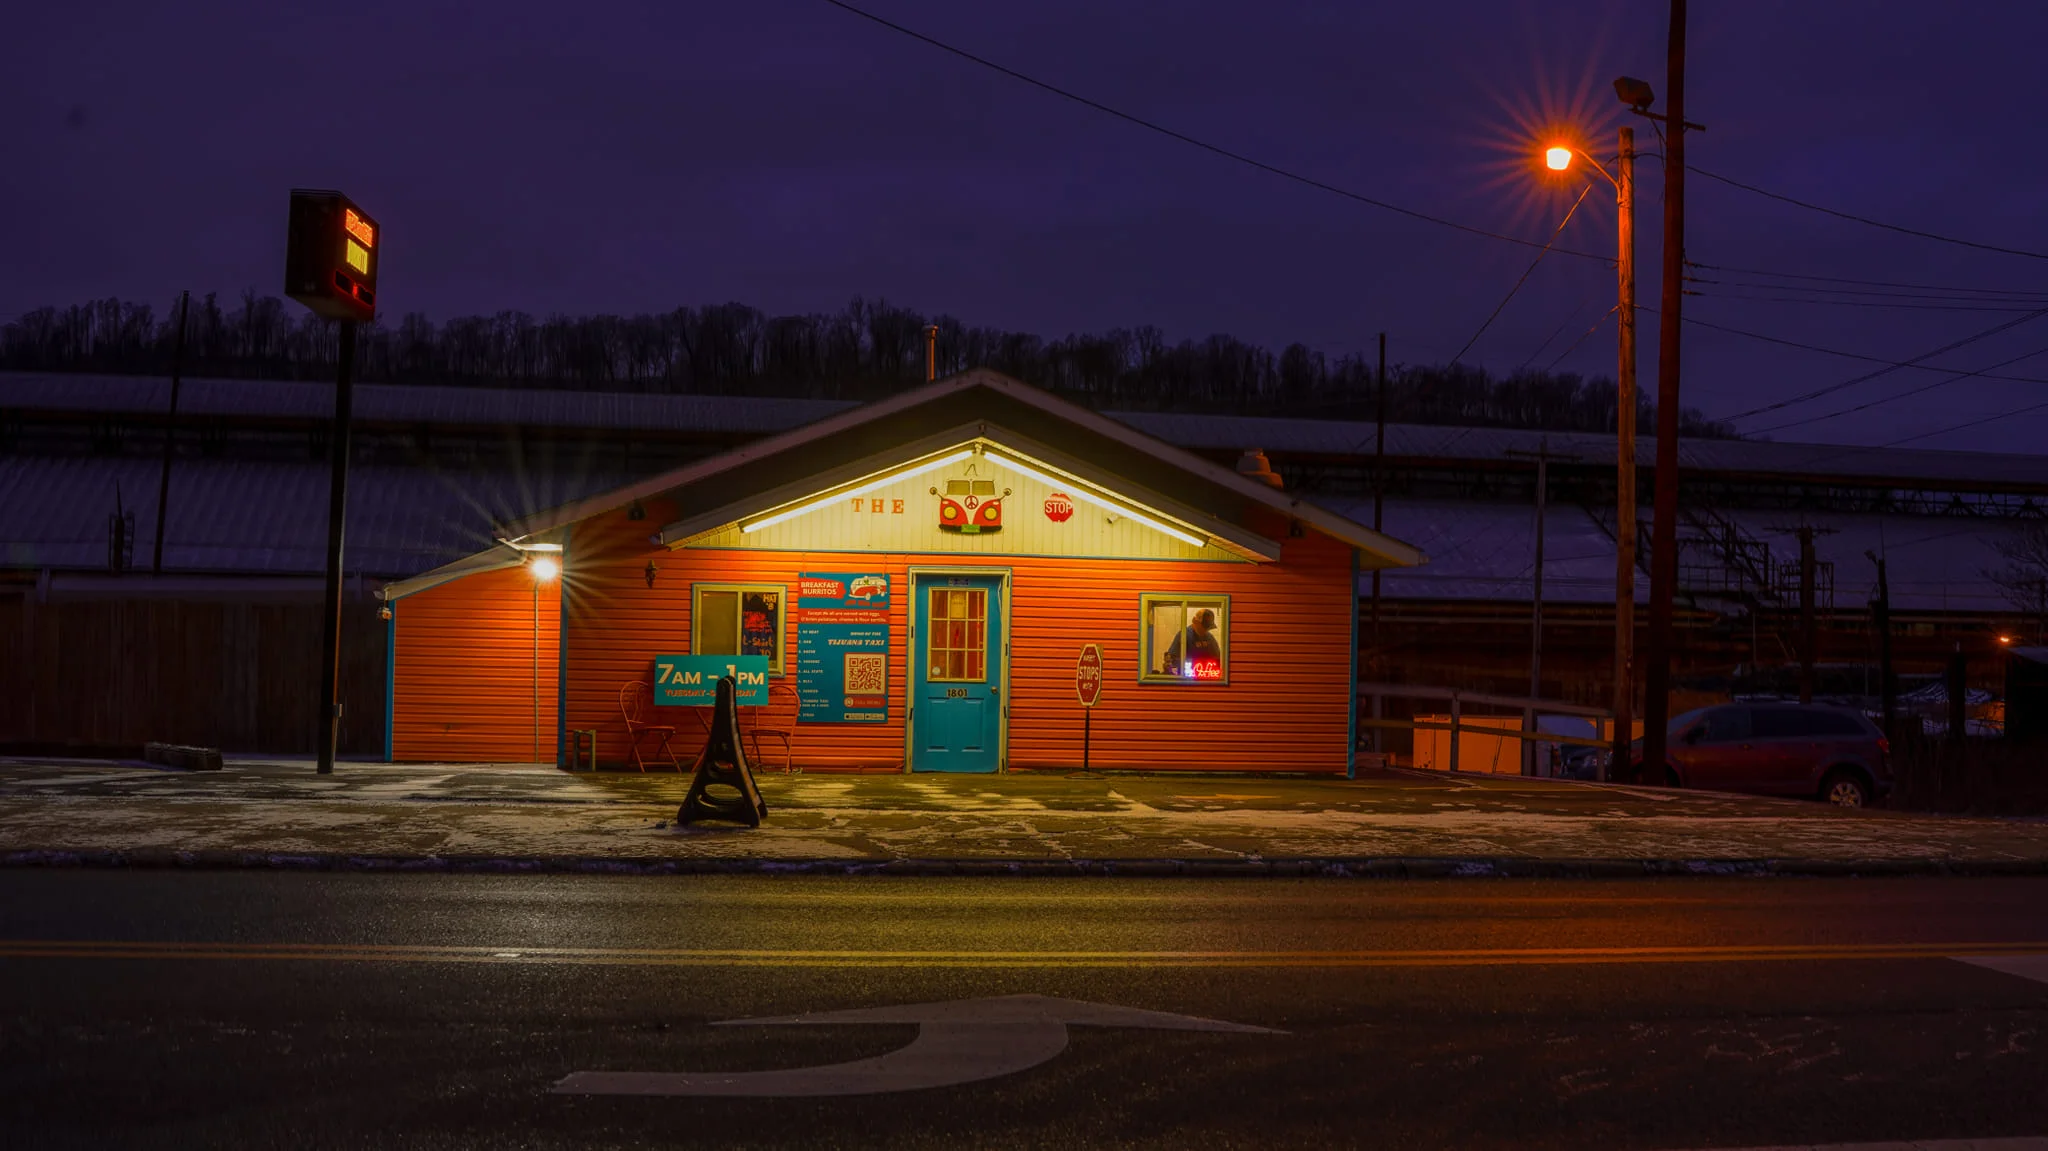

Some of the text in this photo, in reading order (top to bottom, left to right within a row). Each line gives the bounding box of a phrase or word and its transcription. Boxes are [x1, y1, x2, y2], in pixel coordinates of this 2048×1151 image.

[851, 498, 904, 514] THE
[1045, 502, 1073, 514] STOP
[800, 581, 839, 589] BREAKFAST
[658, 664, 701, 684] 7AM
[726, 664, 765, 684] 1PM
[1079, 666, 1099, 680] STOPS
[1193, 662, 1221, 678] Coffee
[947, 688, 968, 697] 1801
